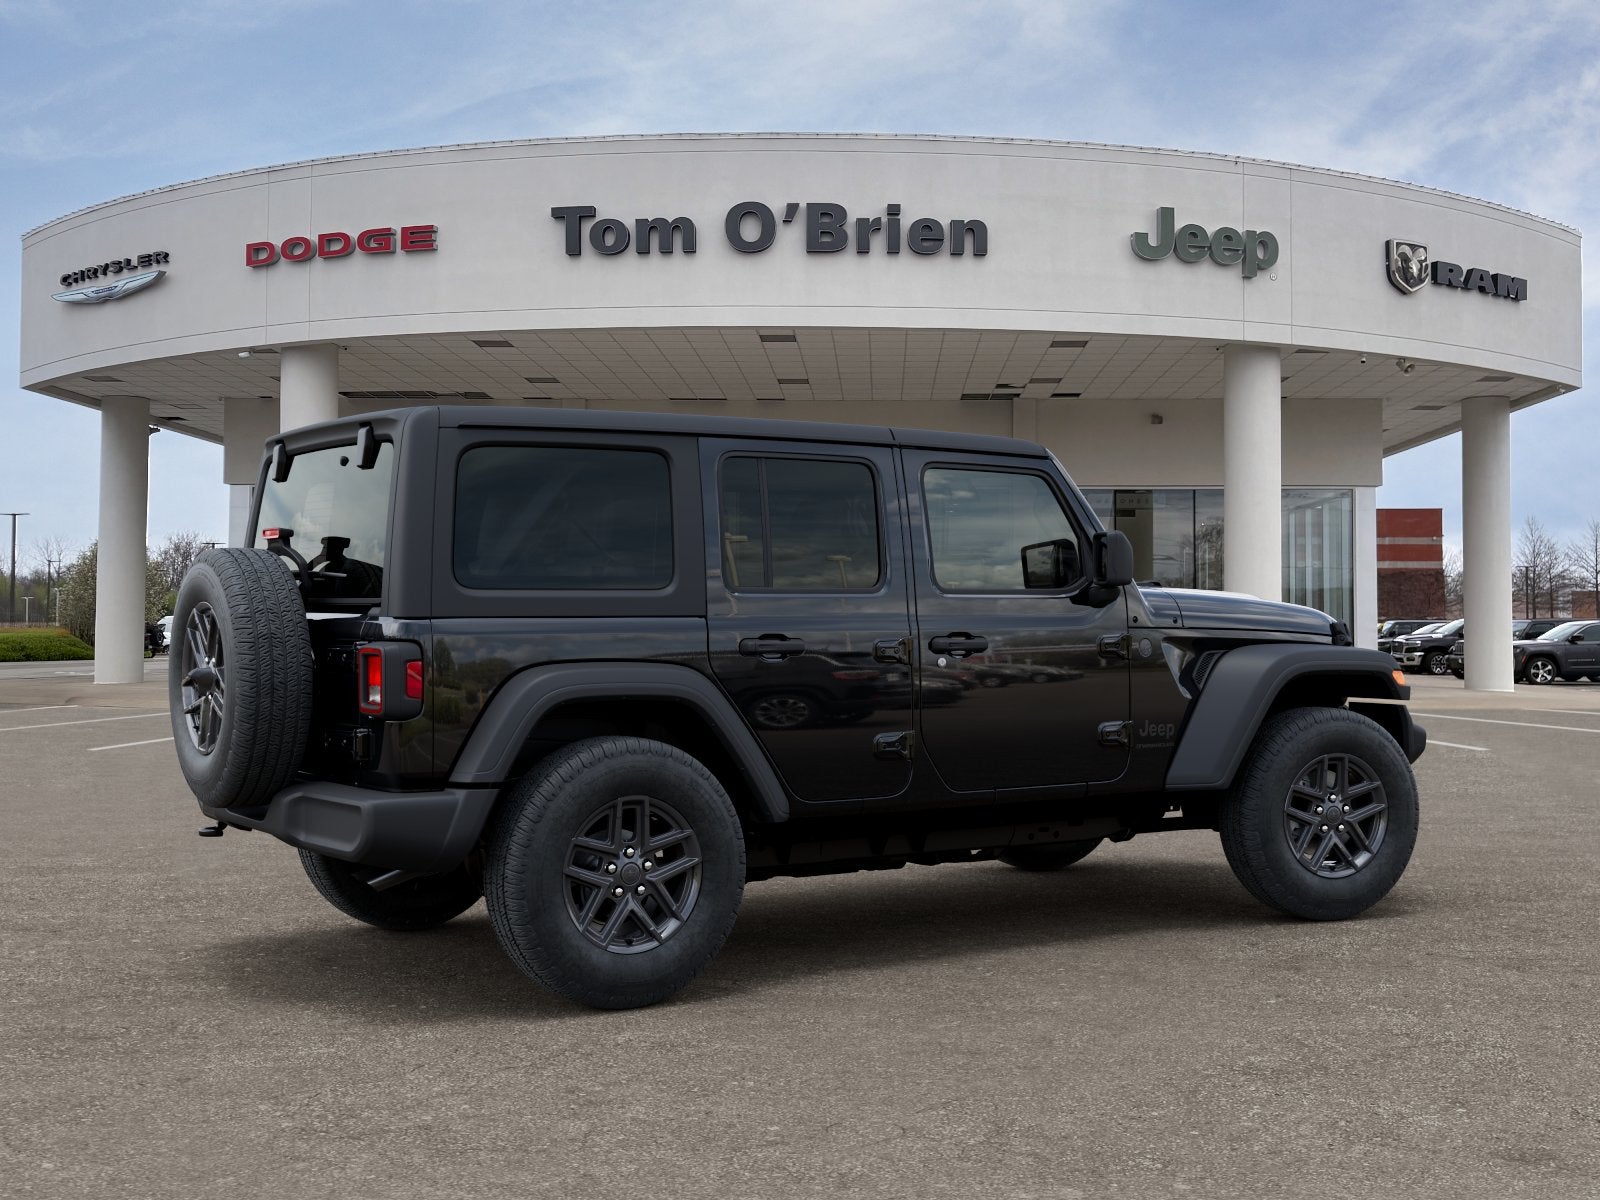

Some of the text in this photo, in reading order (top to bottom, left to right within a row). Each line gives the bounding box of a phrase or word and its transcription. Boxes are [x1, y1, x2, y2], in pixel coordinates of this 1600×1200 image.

[246, 225, 438, 268] DODGE
[551, 201, 989, 257] Tom O'Brien
[1130, 206, 1280, 279] Jeep
[60, 251, 170, 287] CHRYSLER
[1431, 260, 1528, 301] RAM
[1139, 719, 1175, 739] Jeep
